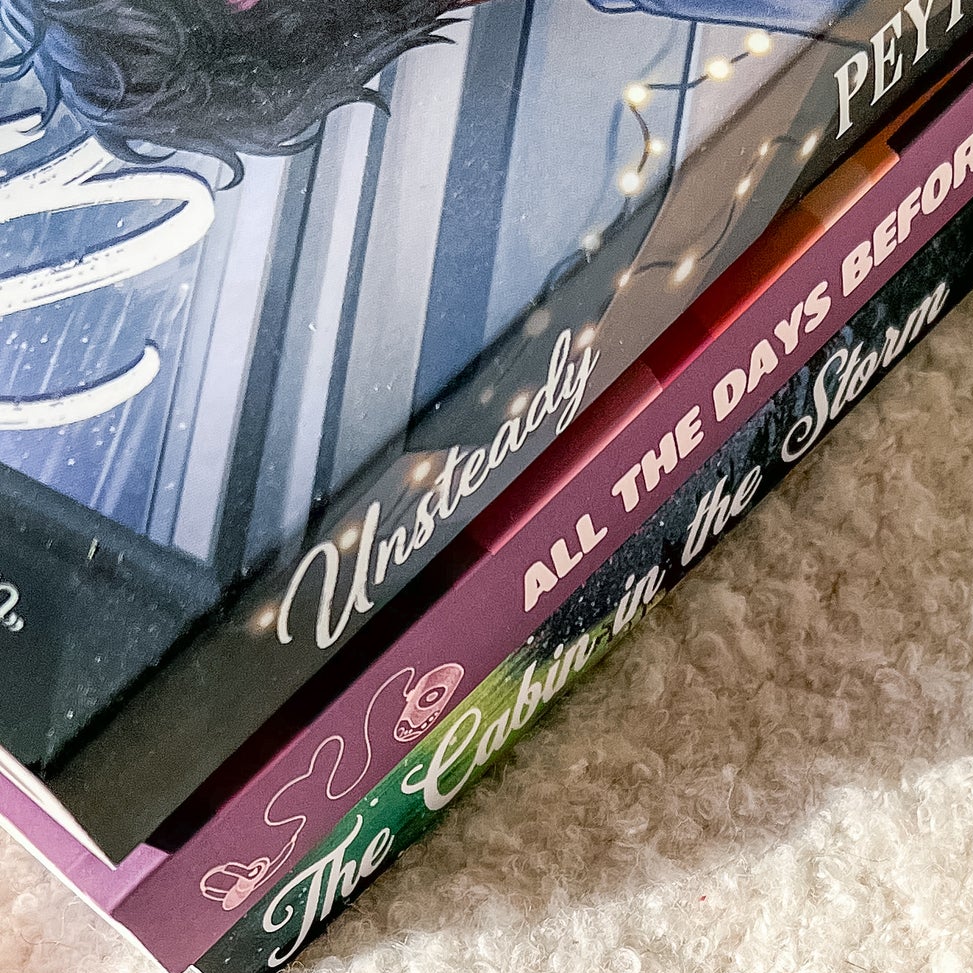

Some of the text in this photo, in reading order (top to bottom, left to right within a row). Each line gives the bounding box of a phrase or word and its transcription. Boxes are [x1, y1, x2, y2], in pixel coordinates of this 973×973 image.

[277, 329, 602, 650] Unsteady
[523, 513, 608, 612] ALL
[611, 405, 705, 513] THE
[712, 281, 832, 423] DAYS
[262, 282, 949, 968] The Cabin in the Storm
